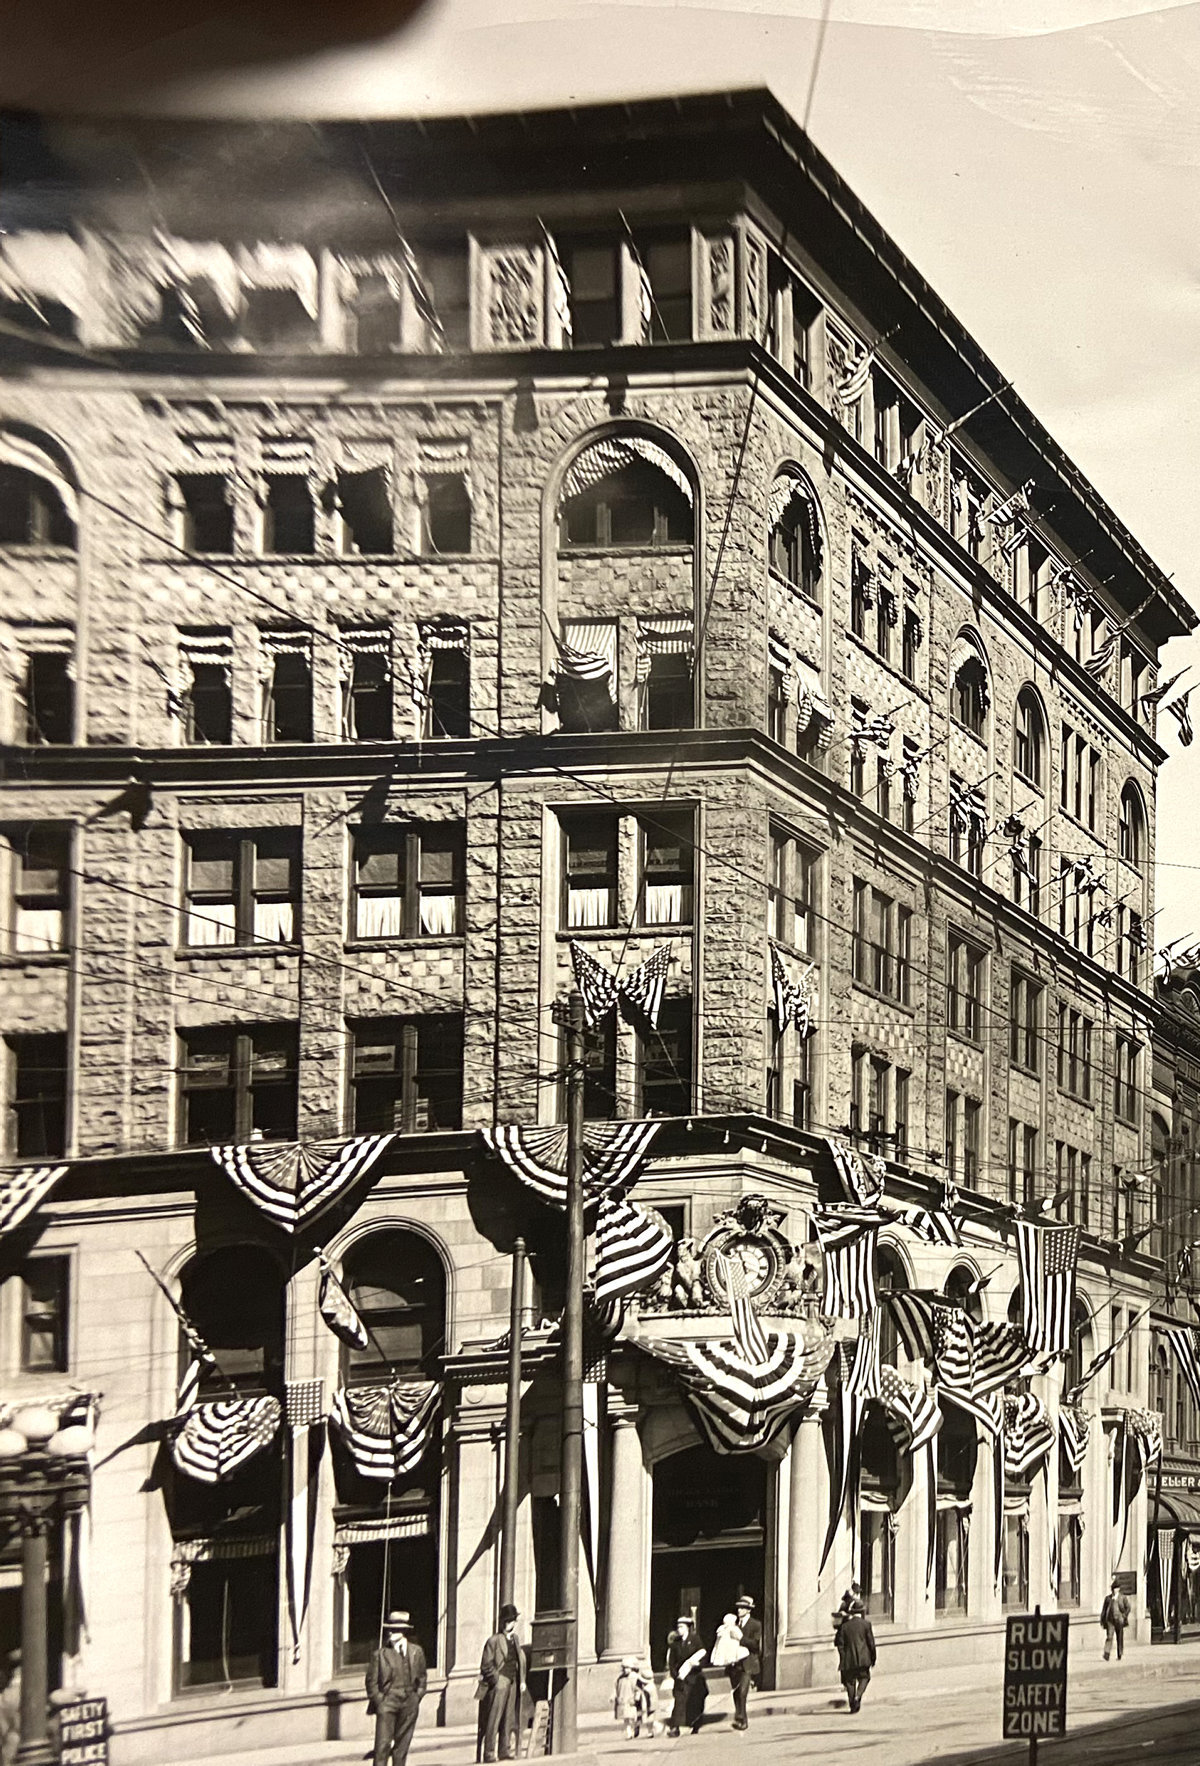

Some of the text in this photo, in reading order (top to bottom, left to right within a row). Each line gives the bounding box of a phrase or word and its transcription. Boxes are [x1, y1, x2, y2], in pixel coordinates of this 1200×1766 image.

[1010, 1621, 1062, 1645] RUN
[1007, 1650, 1064, 1671] SLOW
[1006, 1683, 1063, 1707] SAFETY
[60, 1702, 104, 1724] SAFETY
[1007, 1710, 1060, 1734] ZONE
[62, 1719, 104, 1742] FIRST
[61, 1742, 107, 1765] POLICE
